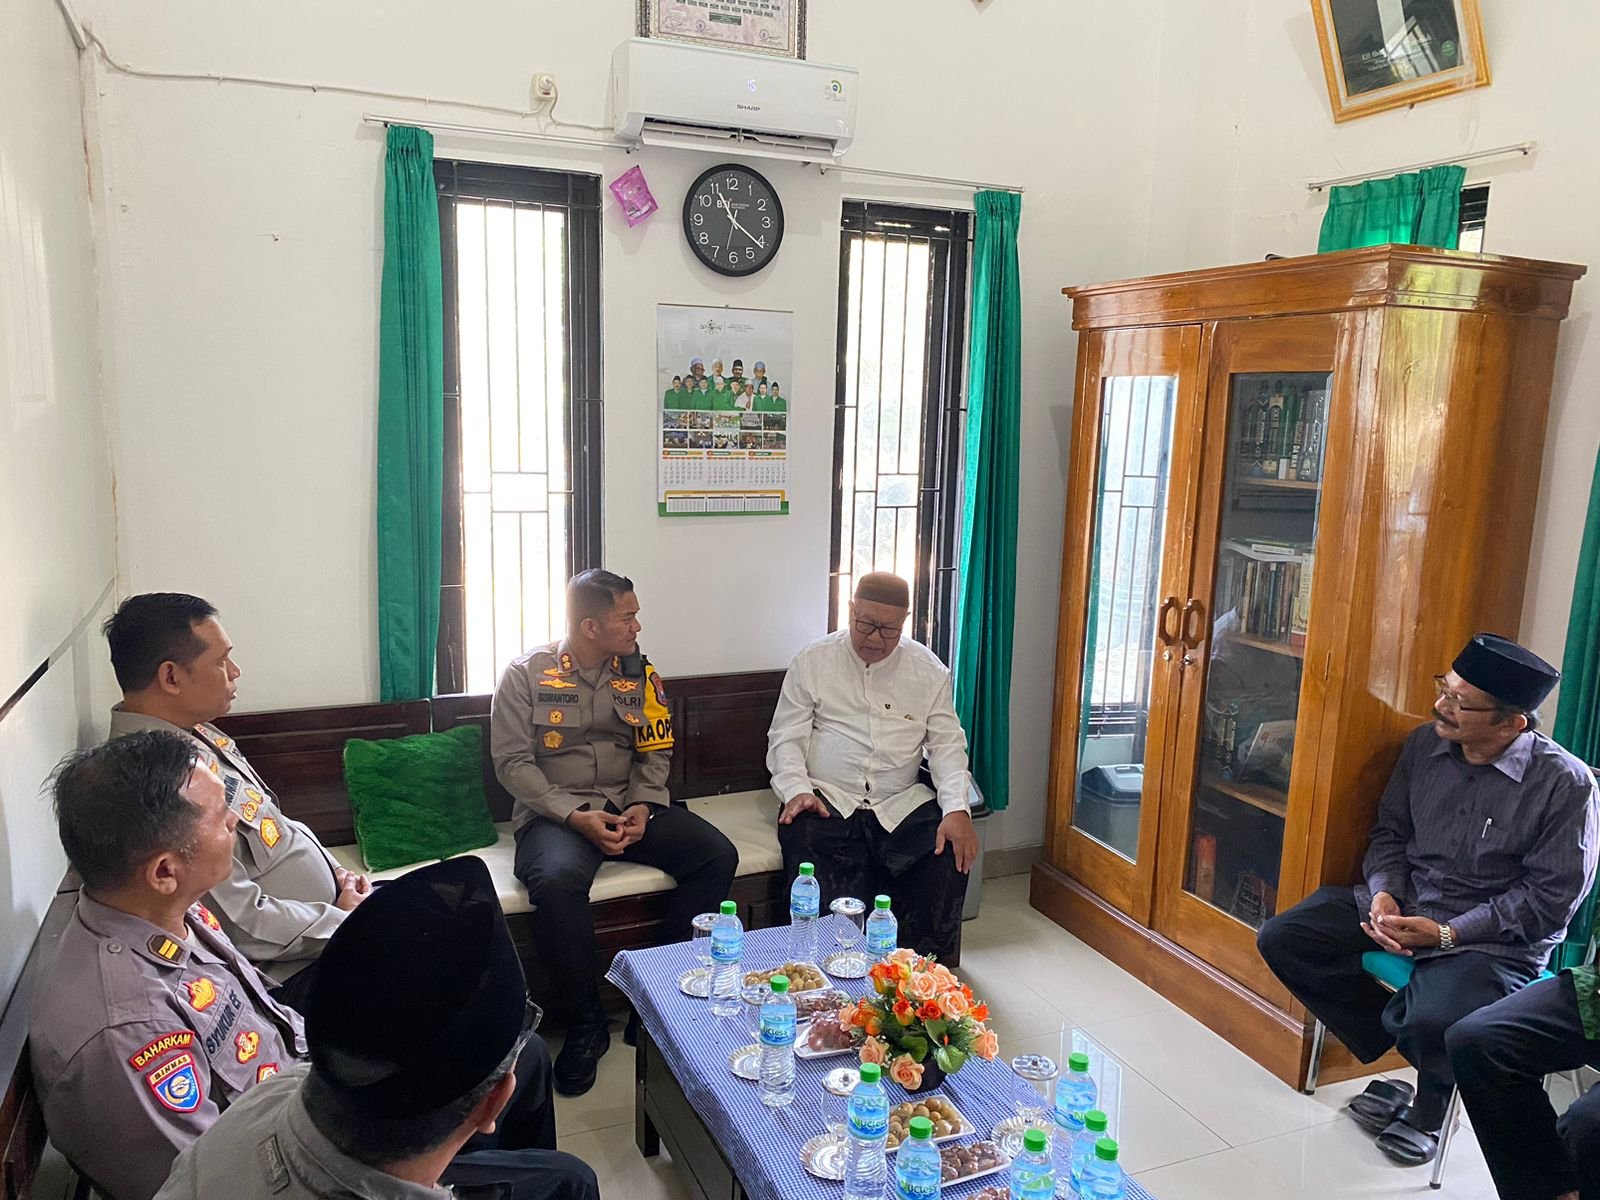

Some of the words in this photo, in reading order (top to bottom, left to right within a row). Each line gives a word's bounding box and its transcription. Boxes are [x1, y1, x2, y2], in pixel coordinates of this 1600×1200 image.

[710, 182, 719, 195] 11
[726, 177, 739, 191] 12
[748, 184, 752, 197] 1
[698, 194, 712, 208] 10
[757, 198, 767, 211] 2
[693, 213, 704, 226] 9
[761, 216, 771, 229] 3
[699, 231, 709, 245] 8
[757, 234, 766, 248] 4
[711, 245, 720, 258] 7
[728, 251, 738, 264] 6
[745, 247, 755, 260] 5
[612, 694, 641, 707] POLRI
[638, 724, 656, 743] KA
[206, 1004, 236, 1054] SYUKUR
[134, 1033, 191, 1067] BAHARKAM
[154, 1056, 187, 1081] BINMAS
